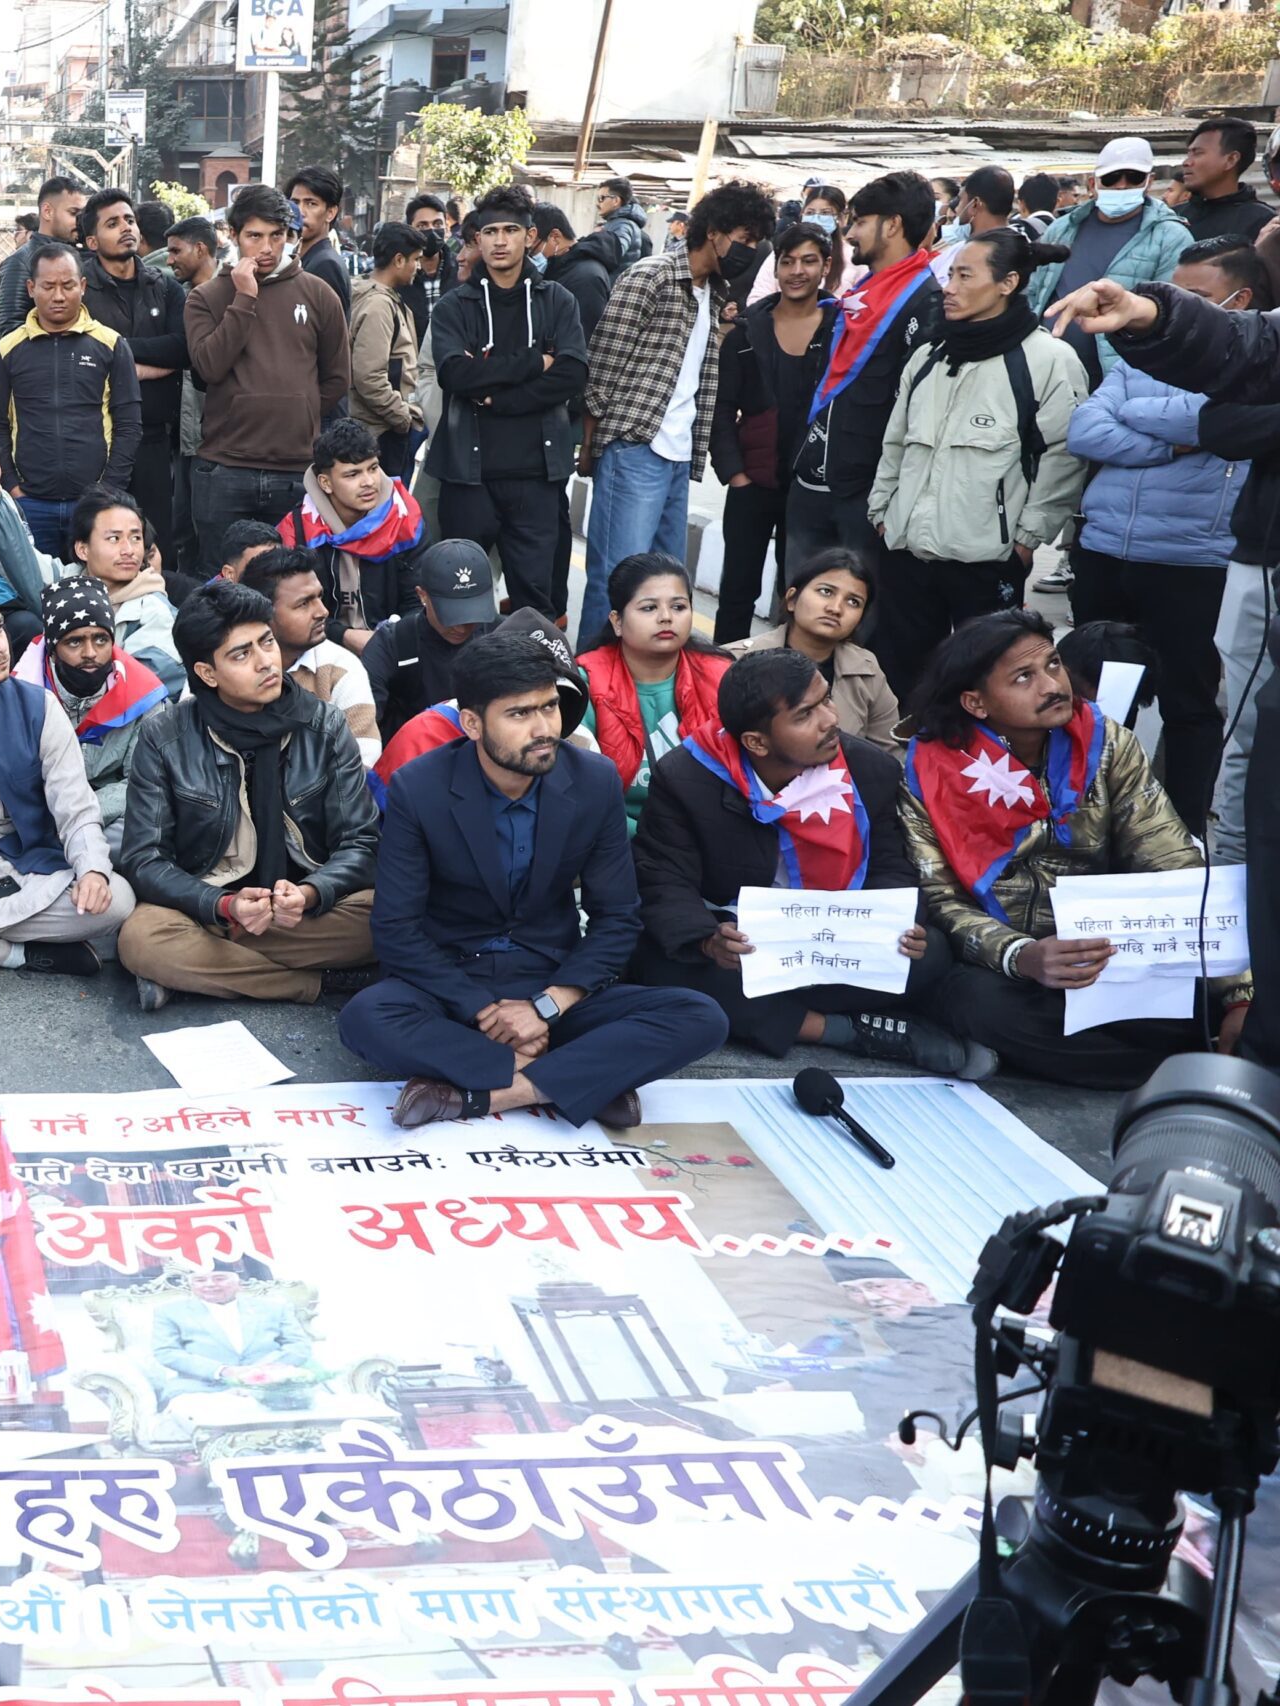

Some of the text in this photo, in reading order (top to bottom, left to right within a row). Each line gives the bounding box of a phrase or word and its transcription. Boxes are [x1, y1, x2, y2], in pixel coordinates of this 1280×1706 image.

[780, 904, 872, 919] पहिला निकास
[1074, 916, 1113, 933] पहिला
[1120, 914, 1176, 931] जेनजीको
[1216, 914, 1239, 931] पुरा
[811, 928, 836, 943] अनि
[1152, 936, 1178, 953] मात्रै
[780, 950, 862, 971] मात्रै निर्वाचन
[30, 1113, 90, 1137] गर्ने
[274, 1102, 367, 1128] नगरे
[15, 1159, 71, 1184] गते
[88, 1160, 151, 1184] देश
[168, 1152, 288, 1179] खरानी
[466, 1143, 647, 1172] एकैठाउँमा
[46, 1186, 275, 1267] अर्को
[148, 1582, 381, 1633] जेनजीको
[410, 1587, 520, 1629] माग
[547, 1567, 775, 1624] संस्थागत
